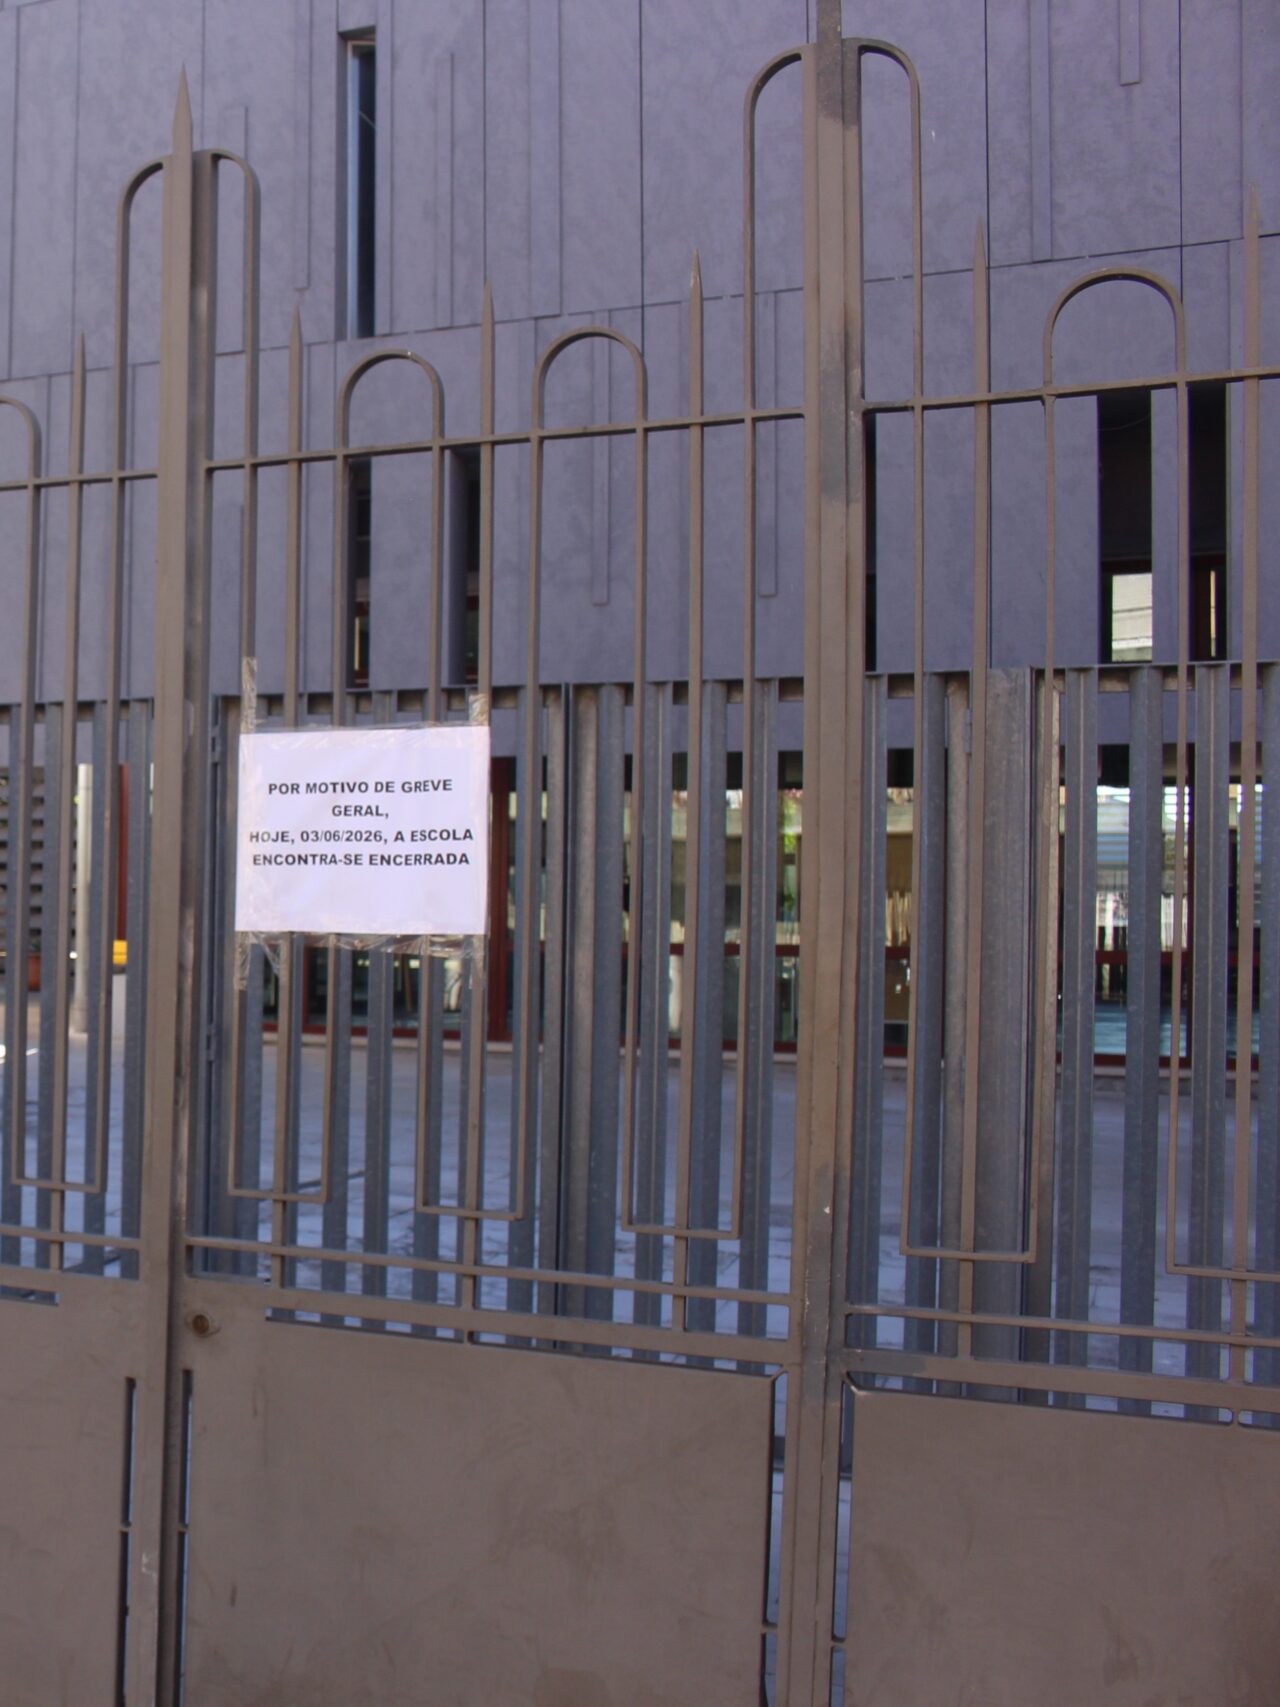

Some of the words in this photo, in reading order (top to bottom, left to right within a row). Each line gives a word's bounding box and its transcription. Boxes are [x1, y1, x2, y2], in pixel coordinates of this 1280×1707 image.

[268, 783, 300, 795] POR
[305, 781, 369, 795] MOTIVO
[374, 781, 395, 793] DE
[401, 779, 453, 793] GREVE
[332, 805, 389, 819] GERAL,
[249, 831, 295, 845] HOJE,
[300, 830, 388, 845] 03/06/2026,
[394, 831, 405, 842] A
[410, 829, 473, 842] ESCOLA
[253, 854, 363, 866] ENCONTRA-SE
[369, 853, 470, 866] ENCERRADA
